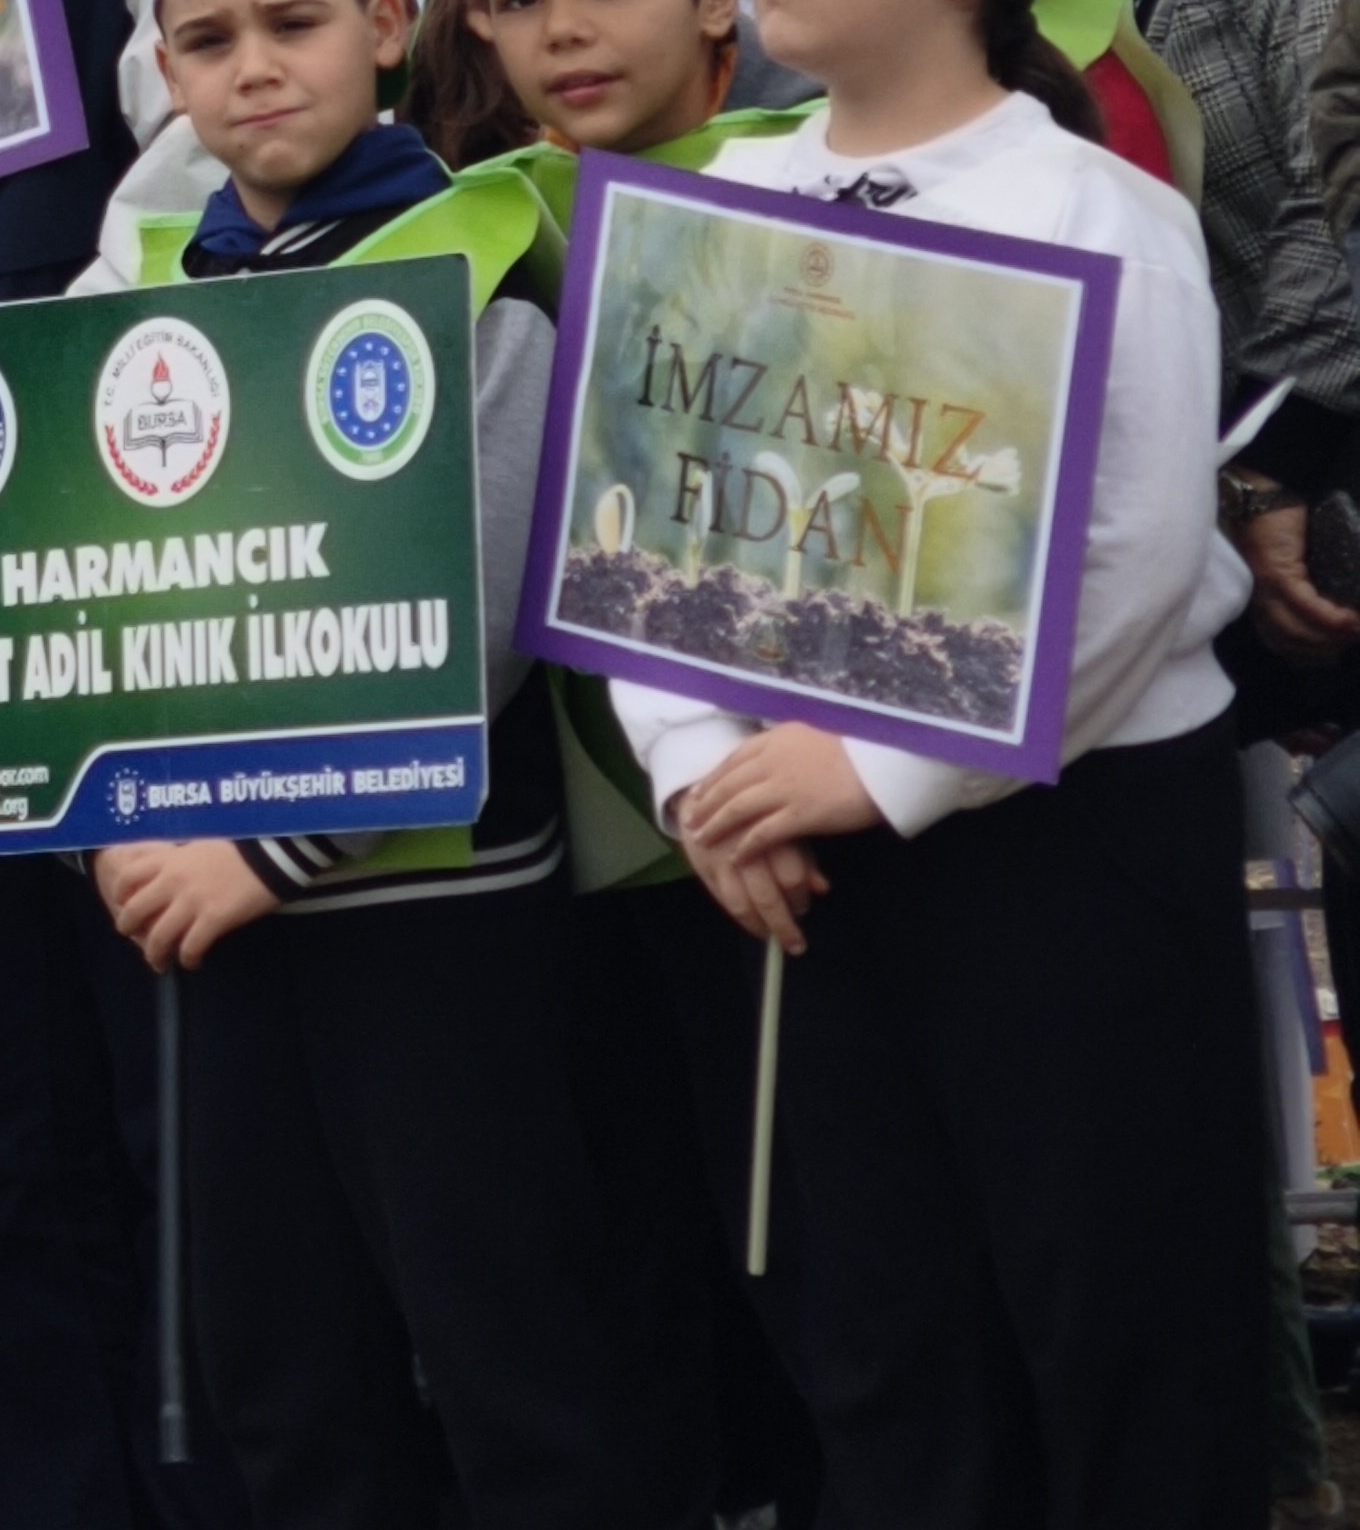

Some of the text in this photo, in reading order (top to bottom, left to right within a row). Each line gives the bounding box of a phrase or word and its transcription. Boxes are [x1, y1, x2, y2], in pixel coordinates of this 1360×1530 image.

[137, 410, 188, 431] BURSA
[636, 324, 987, 481] İMZAMIZ
[669, 451, 914, 575] FİDAN
[1, 522, 331, 607] HARMANCIK
[23, 610, 112, 702] ADİL
[123, 615, 237, 691] KINIK
[247, 594, 449, 682] İLKOKULU
[147, 756, 465, 809] BURSA BÜYÜKŞEHİR BELEDİYESİ
